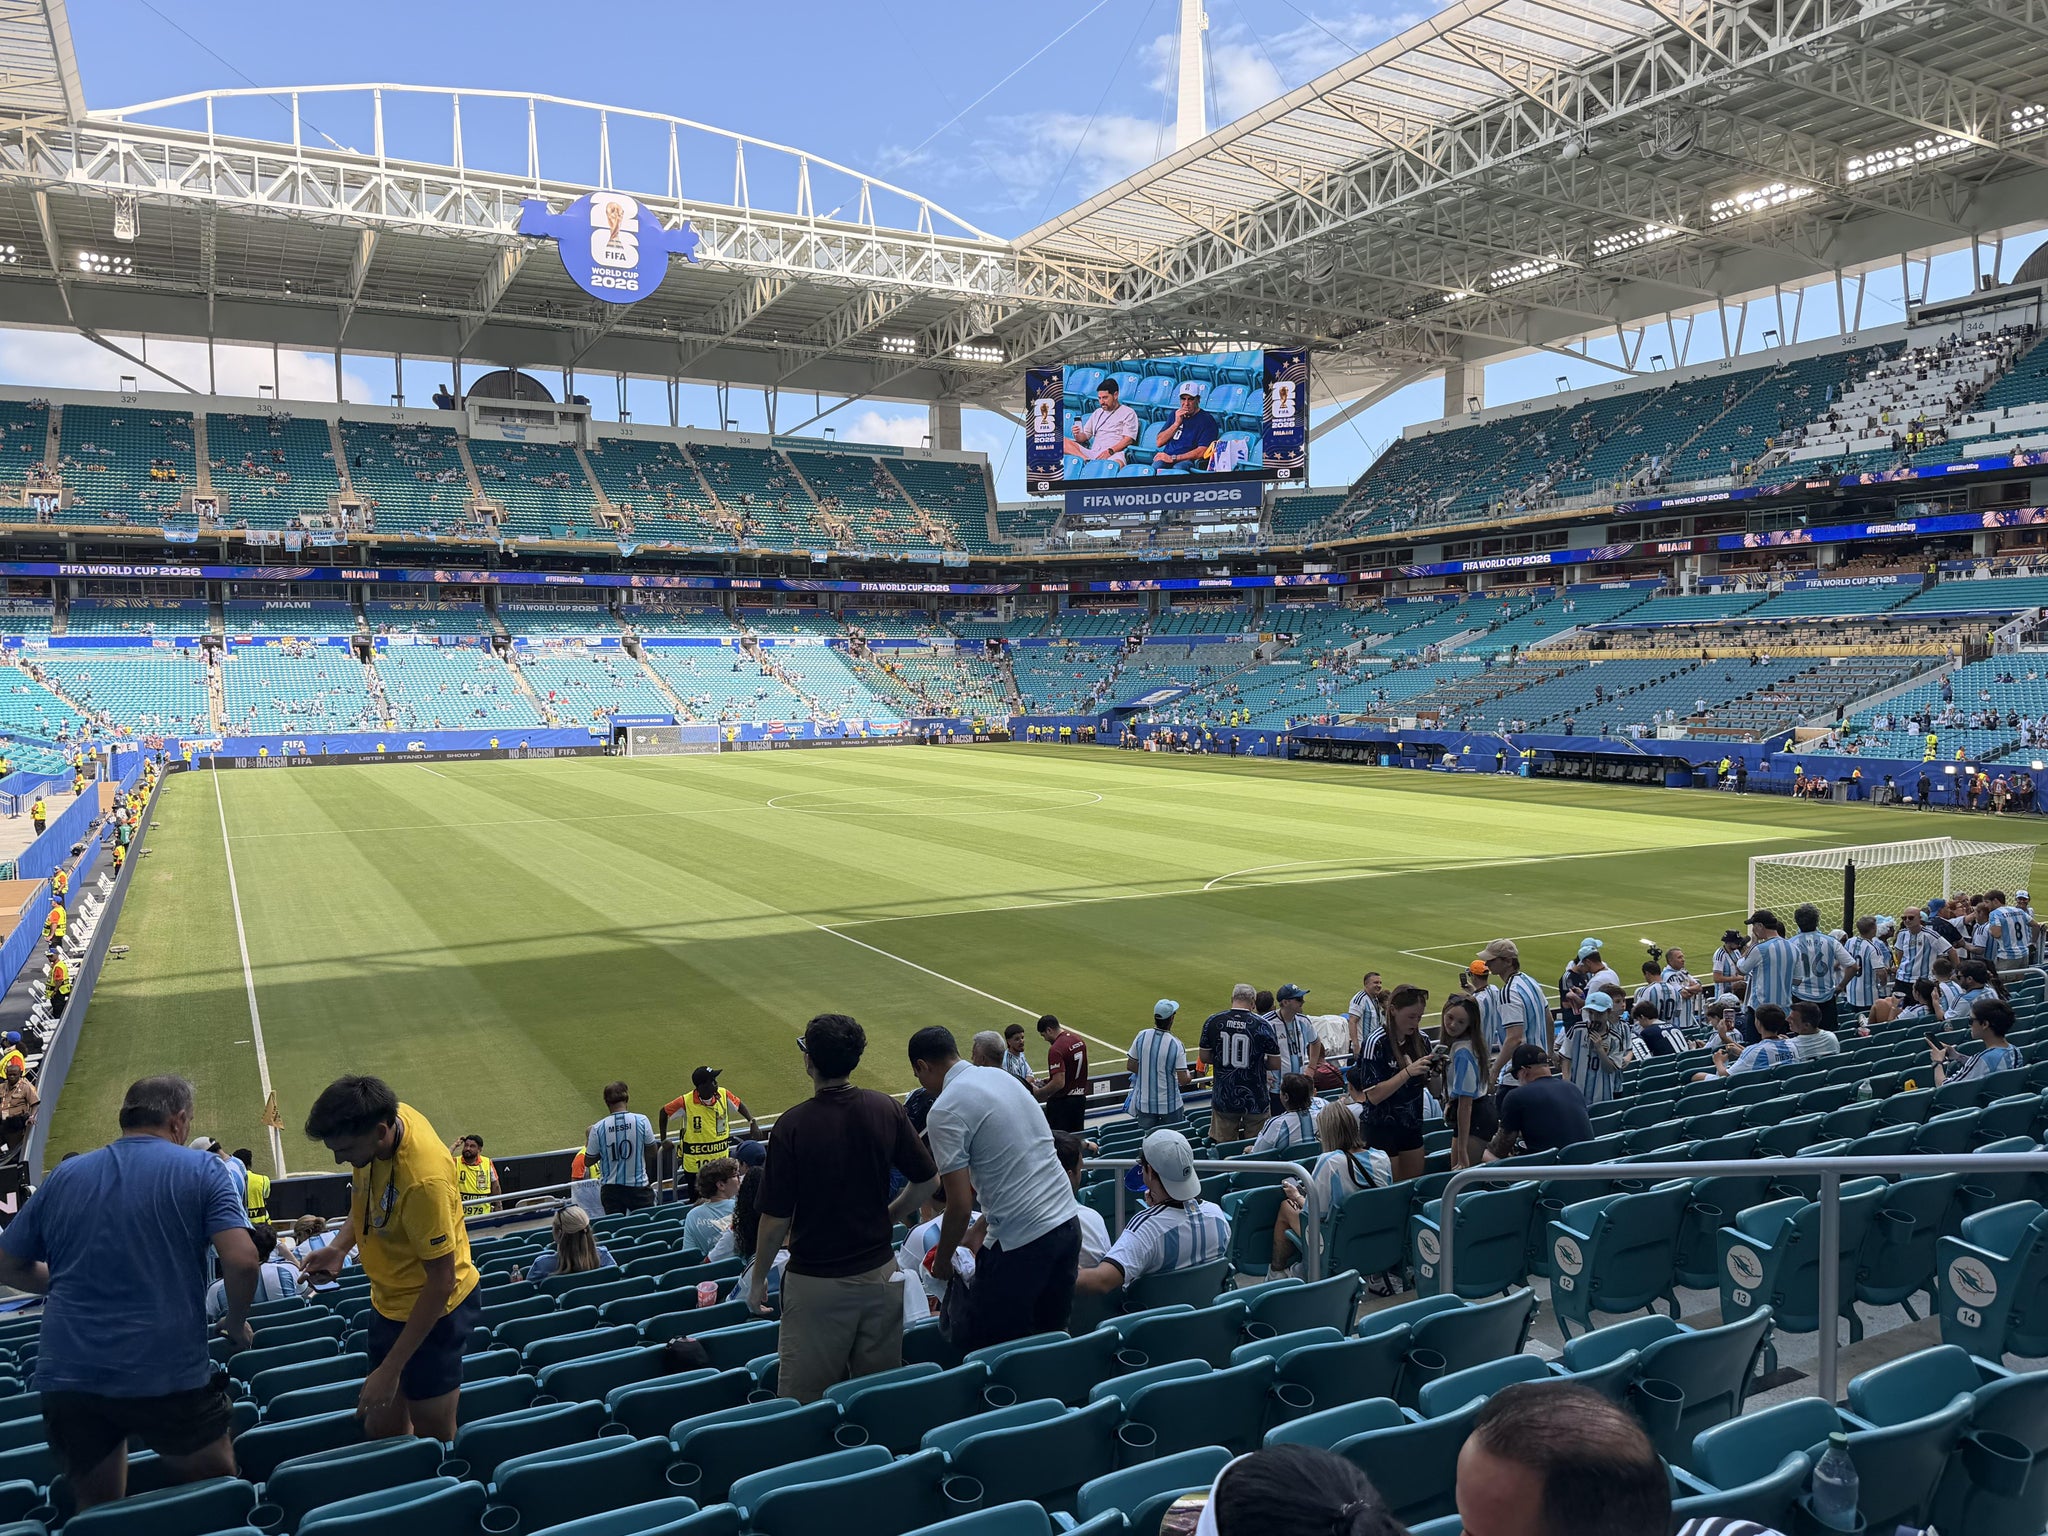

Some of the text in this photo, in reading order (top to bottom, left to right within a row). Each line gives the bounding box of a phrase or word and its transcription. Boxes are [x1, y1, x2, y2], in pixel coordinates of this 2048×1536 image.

[605, 251, 626, 262] FIFA
[592, 267, 638, 279] WORLD CUP
[591, 275, 638, 291] 2026
[1967, 321, 1985, 332] 346
[1842, 336, 1857, 346] 345
[1719, 362, 1732, 370] 344
[1613, 383, 1625, 392] 343
[1521, 402, 1532, 410] 342
[1806, 480, 1830, 489] MIAMI
[1084, 489, 1242, 507] FIFA WORLD CUP 2026
[1658, 542, 1691, 552] MIAMI
[1463, 554, 1550, 571] FIFA WORLD CUP 2026
[60, 566, 201, 576] FIFA WORLD CUP 2026
[342, 570, 379, 579] MIAMI
[1360, 571, 1382, 580] MIAMI
[731, 580, 760, 588] MIAMI
[1806, 576, 1897, 588] FIFA WORLD CUP 2026
[908, 584, 922, 592] CUP
[283, 740, 305, 748] FIFA
[938, 736, 946, 744] NO
[953, 734, 973, 743] RACISM
[732, 742, 740, 751] NO
[748, 740, 772, 750] RACISM
[508, 749, 519, 758] NO
[527, 748, 555, 758] RACISM
[235, 756, 312, 768] NO RACISM FIFA
[2014, 922, 2022, 940] 8
[1801, 952, 1828, 977] 16
[1659, 998, 1675, 1020] 10
[1226, 1020, 1246, 1030] MESSI
[1661, 1029, 1689, 1053] 10
[1220, 1031, 1249, 1069] 10
[1775, 1051, 1796, 1062] MESSI
[1074, 1050, 1083, 1080] 7
[1587, 1055, 1600, 1070] 10
[608, 1124, 632, 1133] MESSI
[606, 1139, 632, 1162] 10
[690, 1141, 728, 1153] SECURITY
[1424, 1266, 1431, 1276] 11
[1562, 1279, 1571, 1287] 12
[1736, 1292, 1746, 1303] 13
[1962, 1311, 1976, 1324] 14
